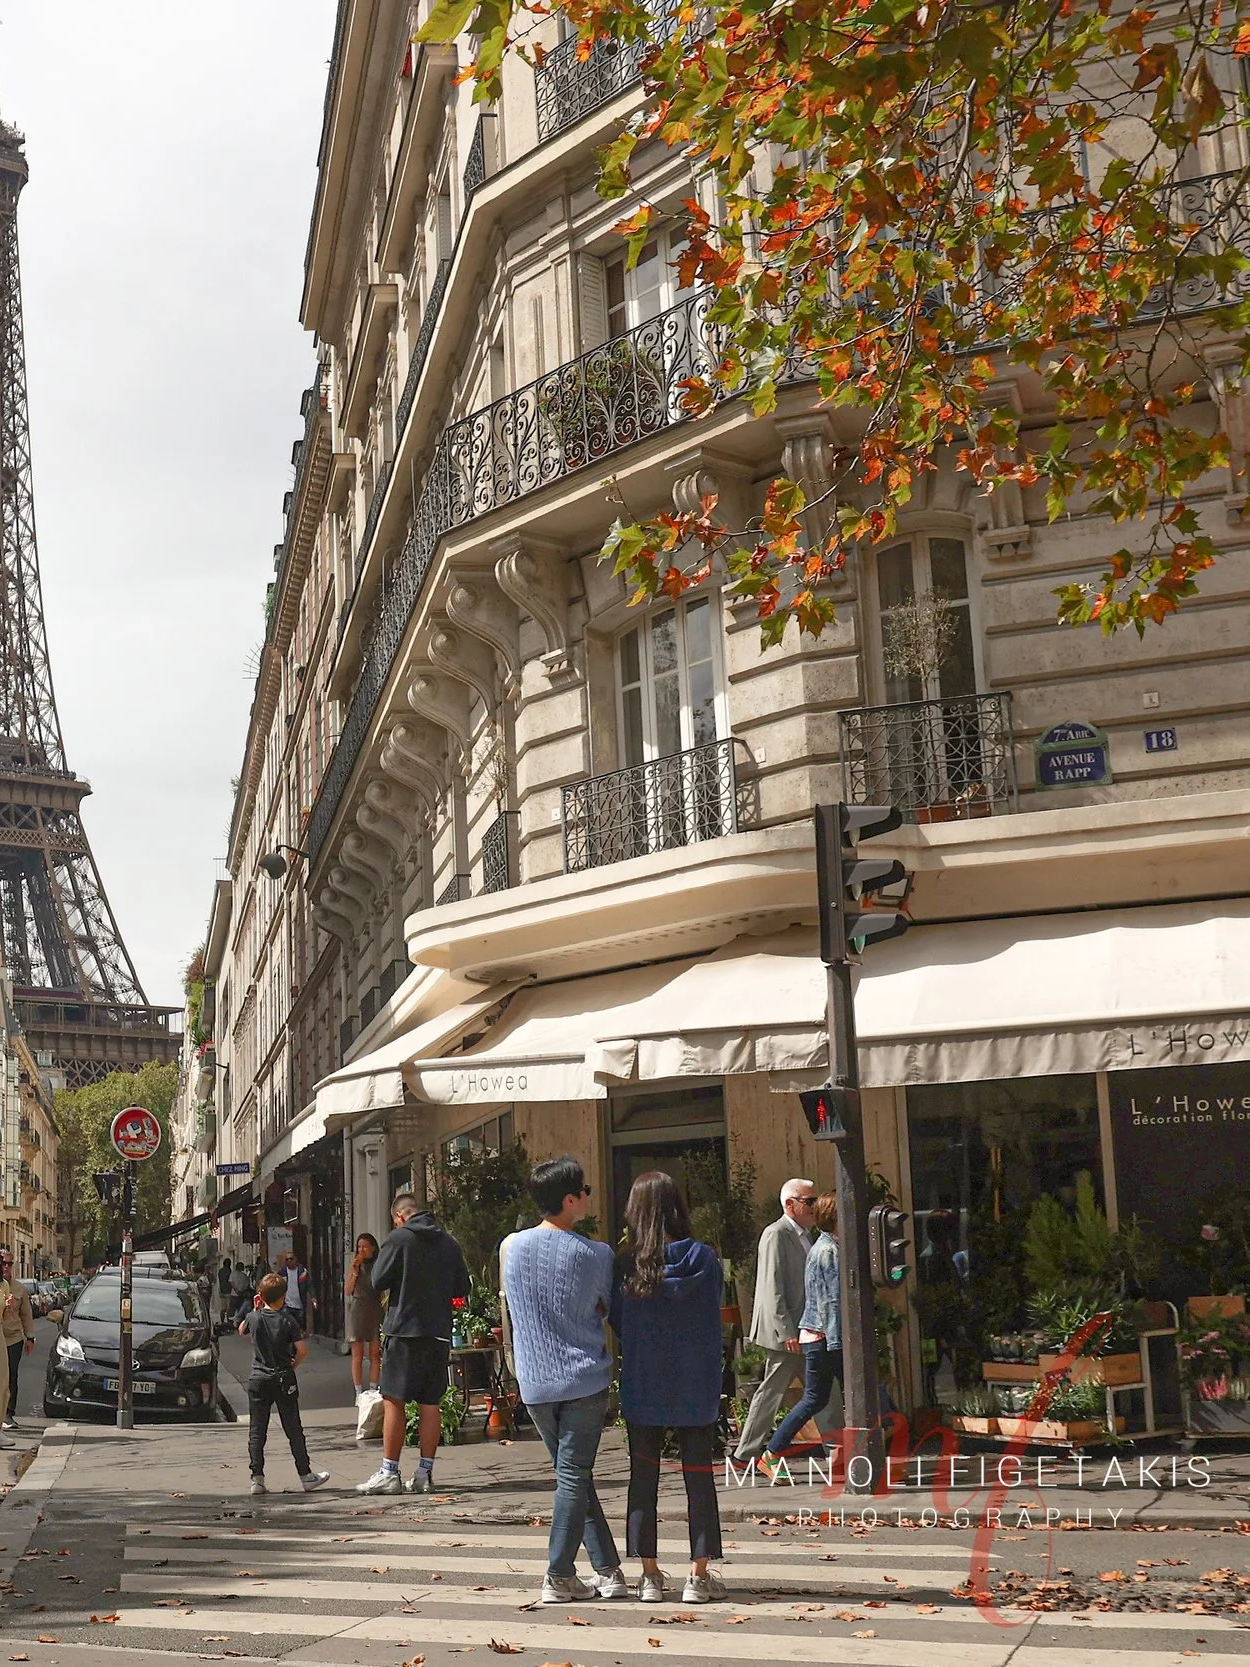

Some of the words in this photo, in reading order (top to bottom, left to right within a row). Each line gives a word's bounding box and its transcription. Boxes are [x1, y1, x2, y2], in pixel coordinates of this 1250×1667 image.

[1150, 731, 1173, 749] 18
[1049, 752, 1096, 768] AVENUE
[1054, 767, 1091, 781] RAPP
[451, 1074, 528, 1094] L'Howea
[1133, 1112, 1213, 1126] décoration
